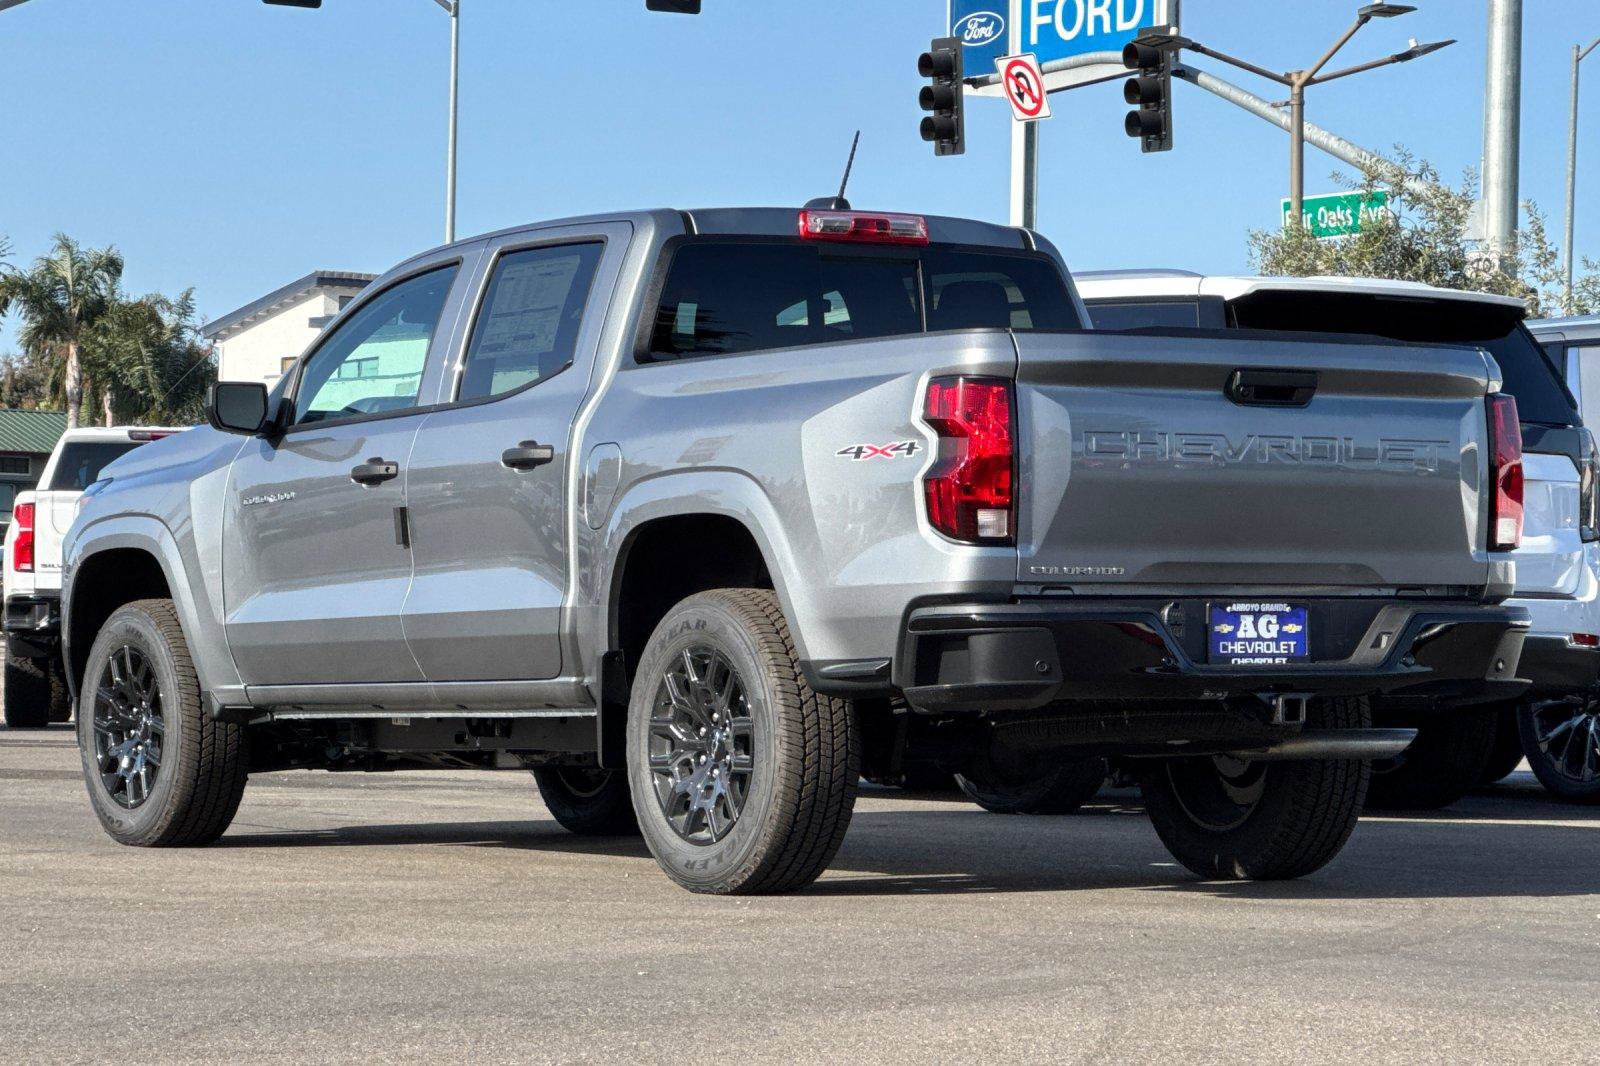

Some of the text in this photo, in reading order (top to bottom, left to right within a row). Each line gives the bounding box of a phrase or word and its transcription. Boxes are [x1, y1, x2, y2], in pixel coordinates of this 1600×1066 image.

[963, 17, 995, 41] Ford
[1029, 0, 1144, 46] FORD
[1285, 209, 1313, 231] Fir
[1317, 205, 1354, 229] Oaks
[1082, 430, 1451, 471] CHEVROLET
[1029, 566, 1125, 576] COLORADO
[1231, 603, 1288, 612] ARROYO GRANDE
[1236, 614, 1280, 639] AG
[1219, 641, 1297, 654] CHEVROLET
